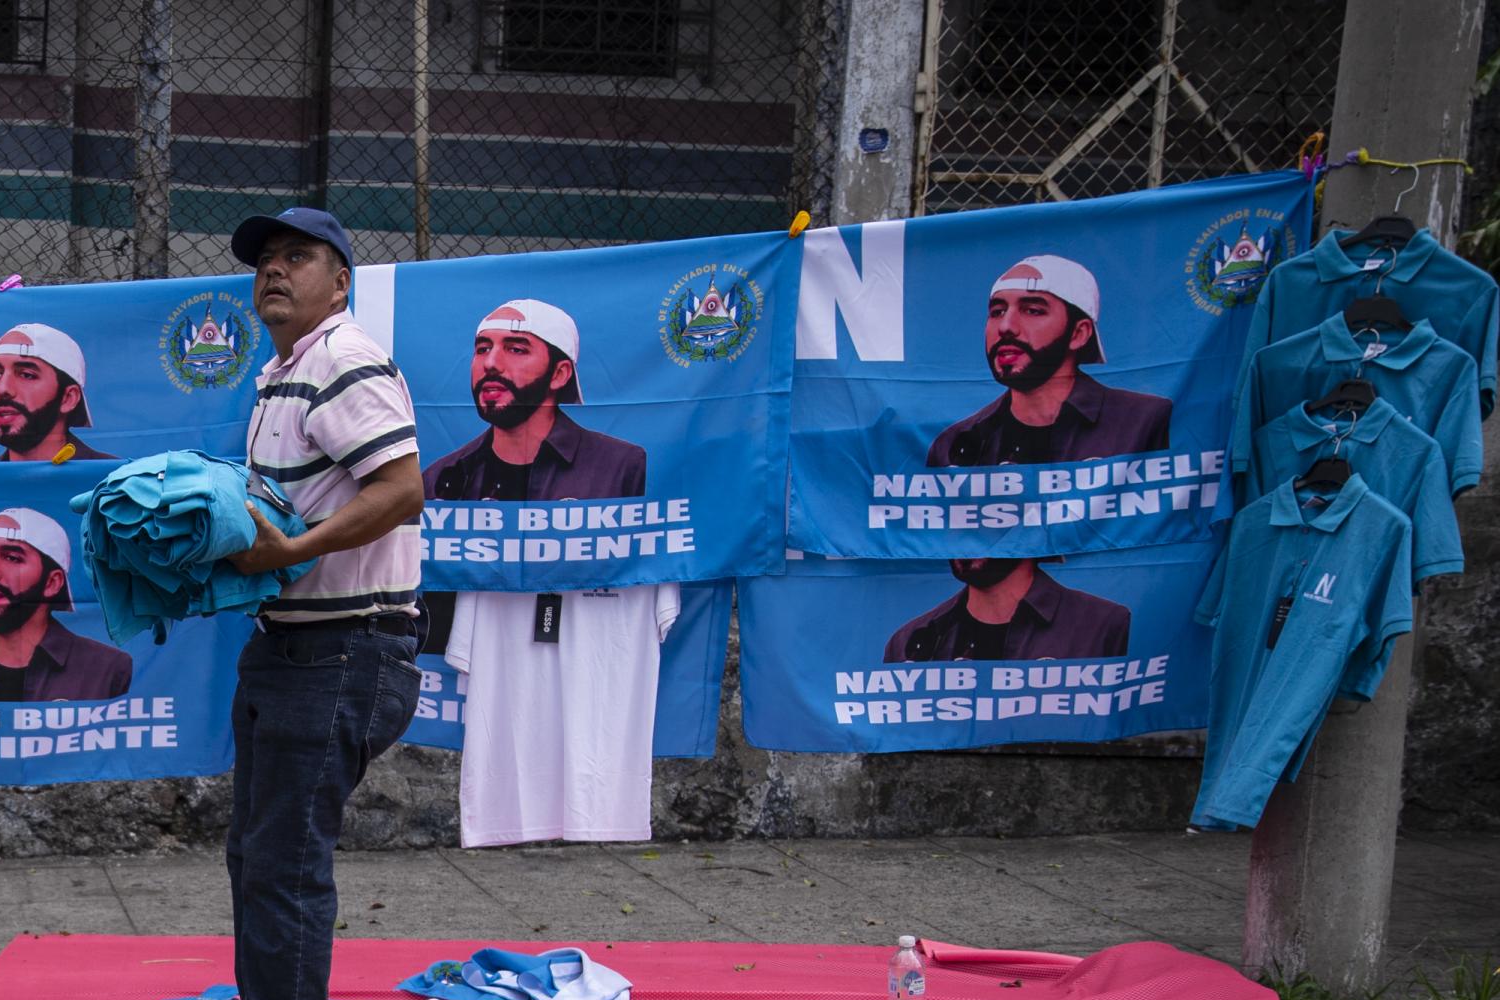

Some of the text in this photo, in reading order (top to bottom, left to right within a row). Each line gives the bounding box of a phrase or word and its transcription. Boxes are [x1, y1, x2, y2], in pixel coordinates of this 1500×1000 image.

[668, 263, 717, 295] SALVADOR
[723, 263, 736, 273] EN
[796, 210, 905, 362] N
[873, 450, 1225, 498] NAYIB BUKELE
[420, 498, 690, 531] YIB BUKELE
[420, 528, 696, 562] ESIDENTE
[1314, 573, 1336, 598] N
[835, 655, 1169, 695] NAYIB BUKELE
[13, 697, 175, 731] BUKELE
[834, 680, 1166, 725] PRESIDENTE
